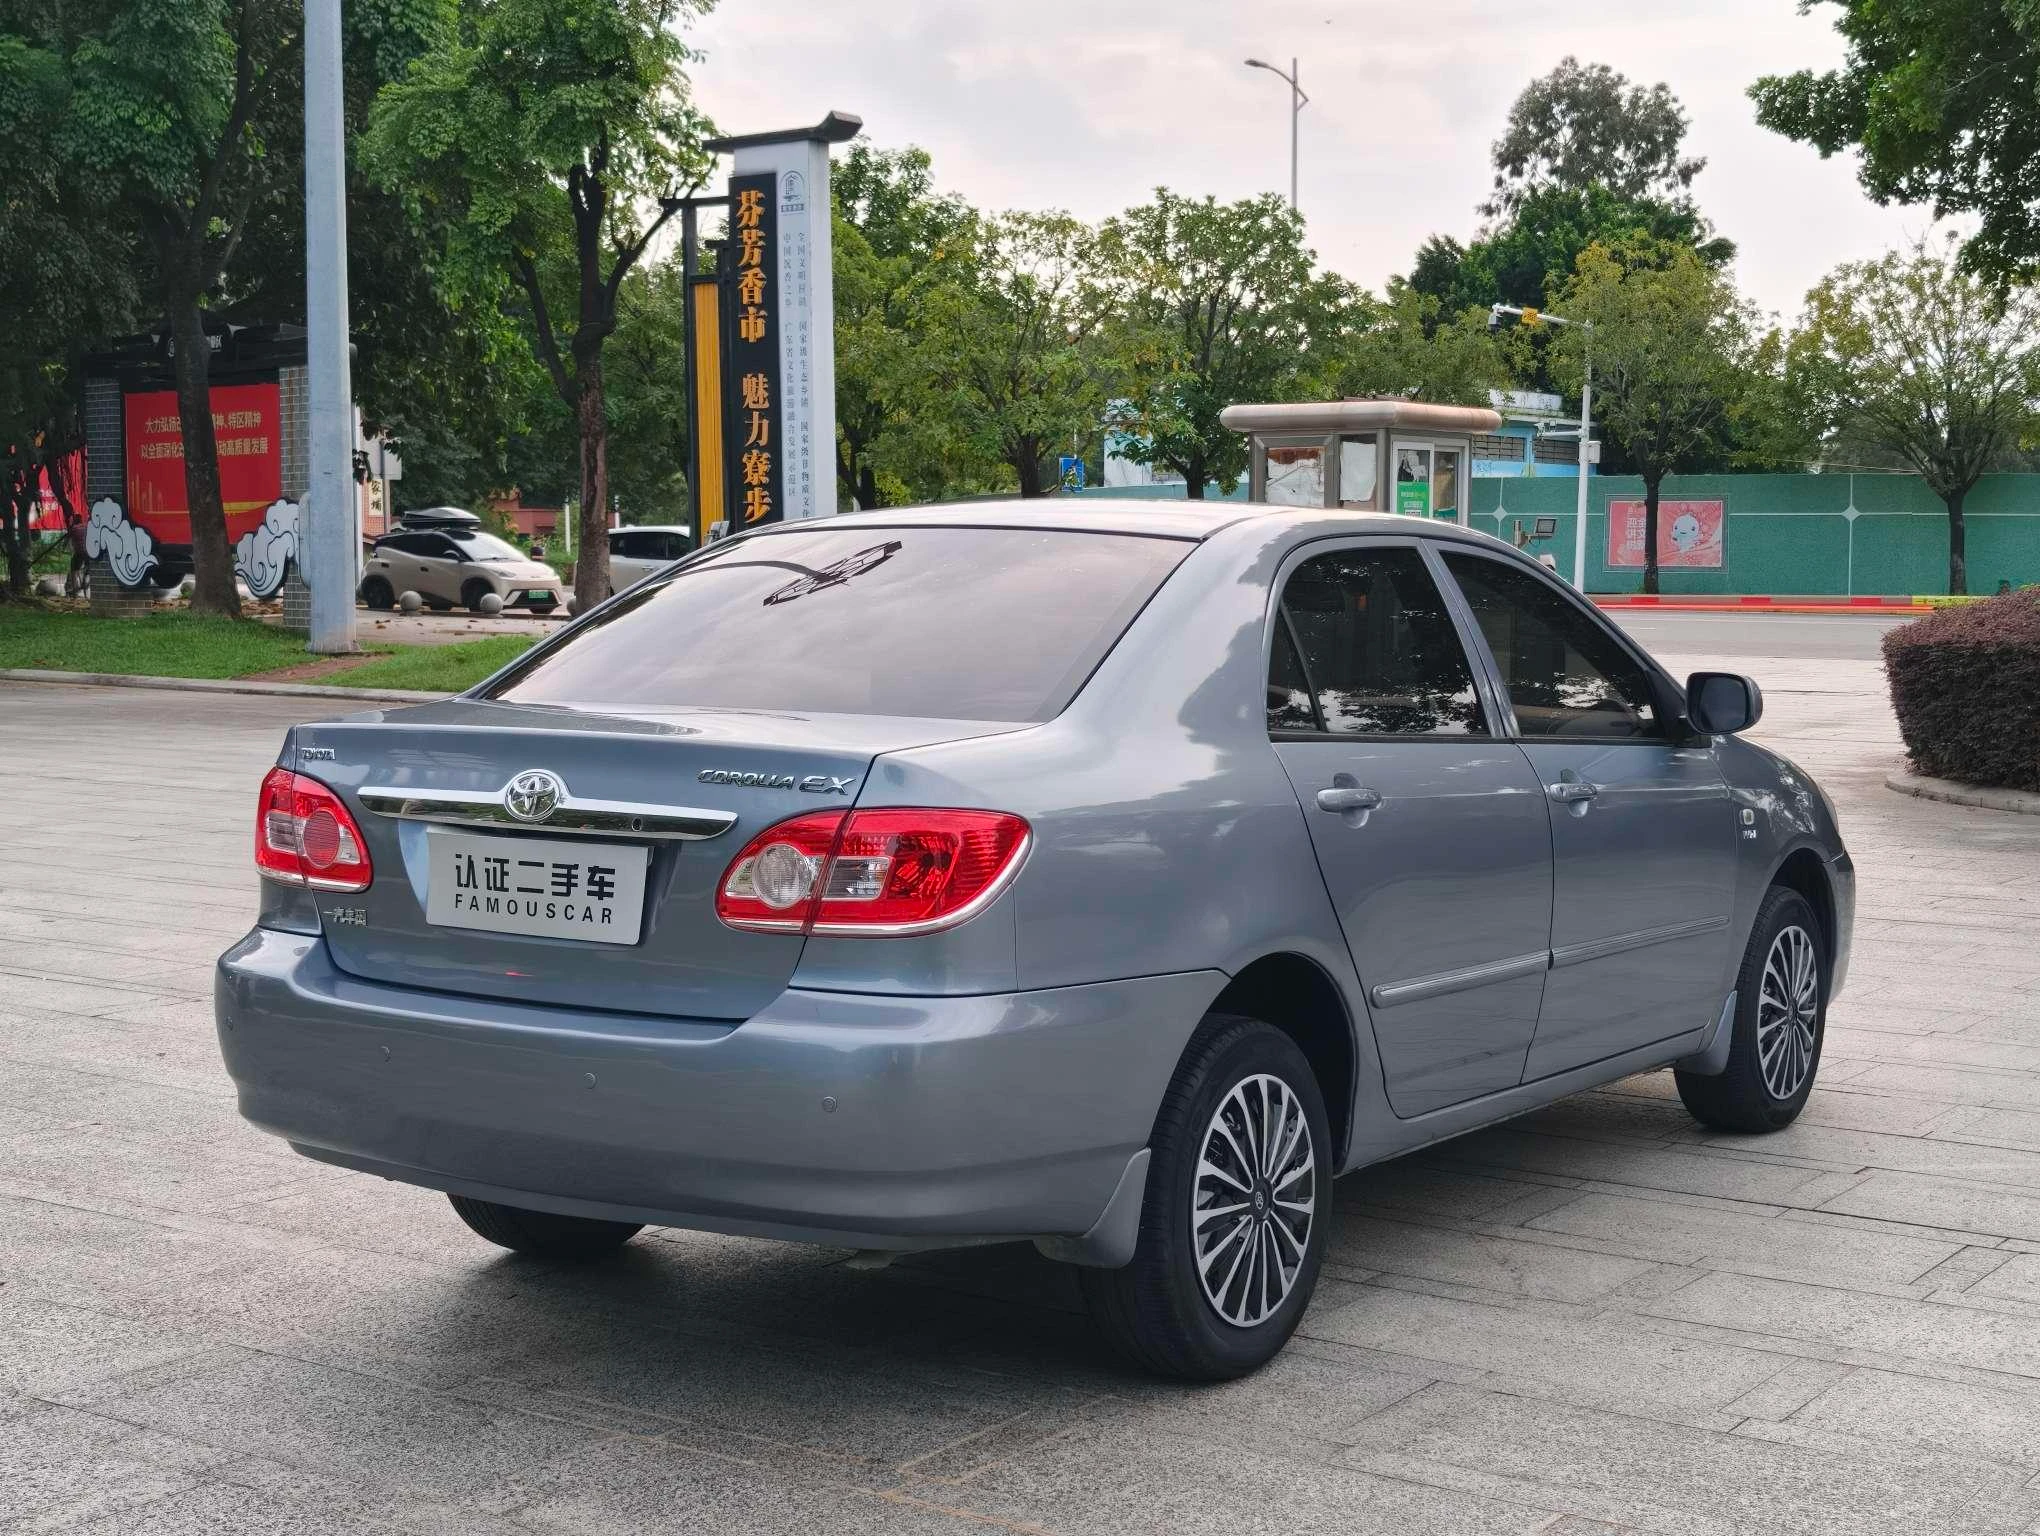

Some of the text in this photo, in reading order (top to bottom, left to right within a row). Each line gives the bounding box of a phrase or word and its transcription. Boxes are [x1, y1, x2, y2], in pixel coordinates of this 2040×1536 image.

[736, 190, 772, 524] 芬芳香市 魅力寮步
[697, 769, 856, 796] COROLLA EX
[455, 853, 616, 901] 认证二手车
[455, 893, 613, 925] FAMOUSCAR
